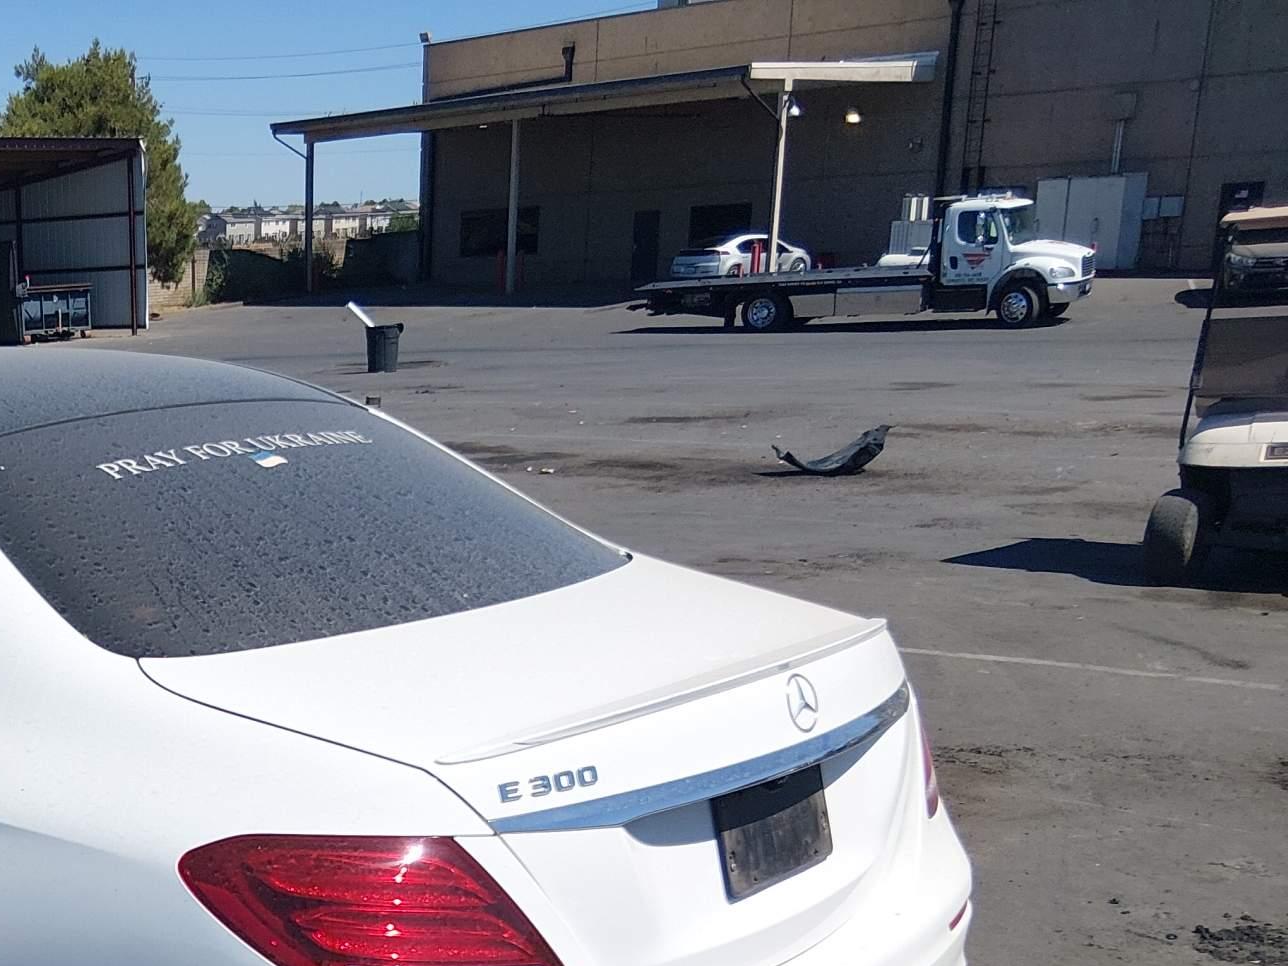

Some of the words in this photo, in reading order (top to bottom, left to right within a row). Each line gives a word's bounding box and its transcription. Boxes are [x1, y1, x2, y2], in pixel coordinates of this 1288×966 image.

[95, 449, 187, 480] PRAY
[183, 440, 255, 460] FOR
[243, 430, 373, 451] UKRAINE
[497, 781, 523, 803] E
[528, 765, 598, 797] 300
